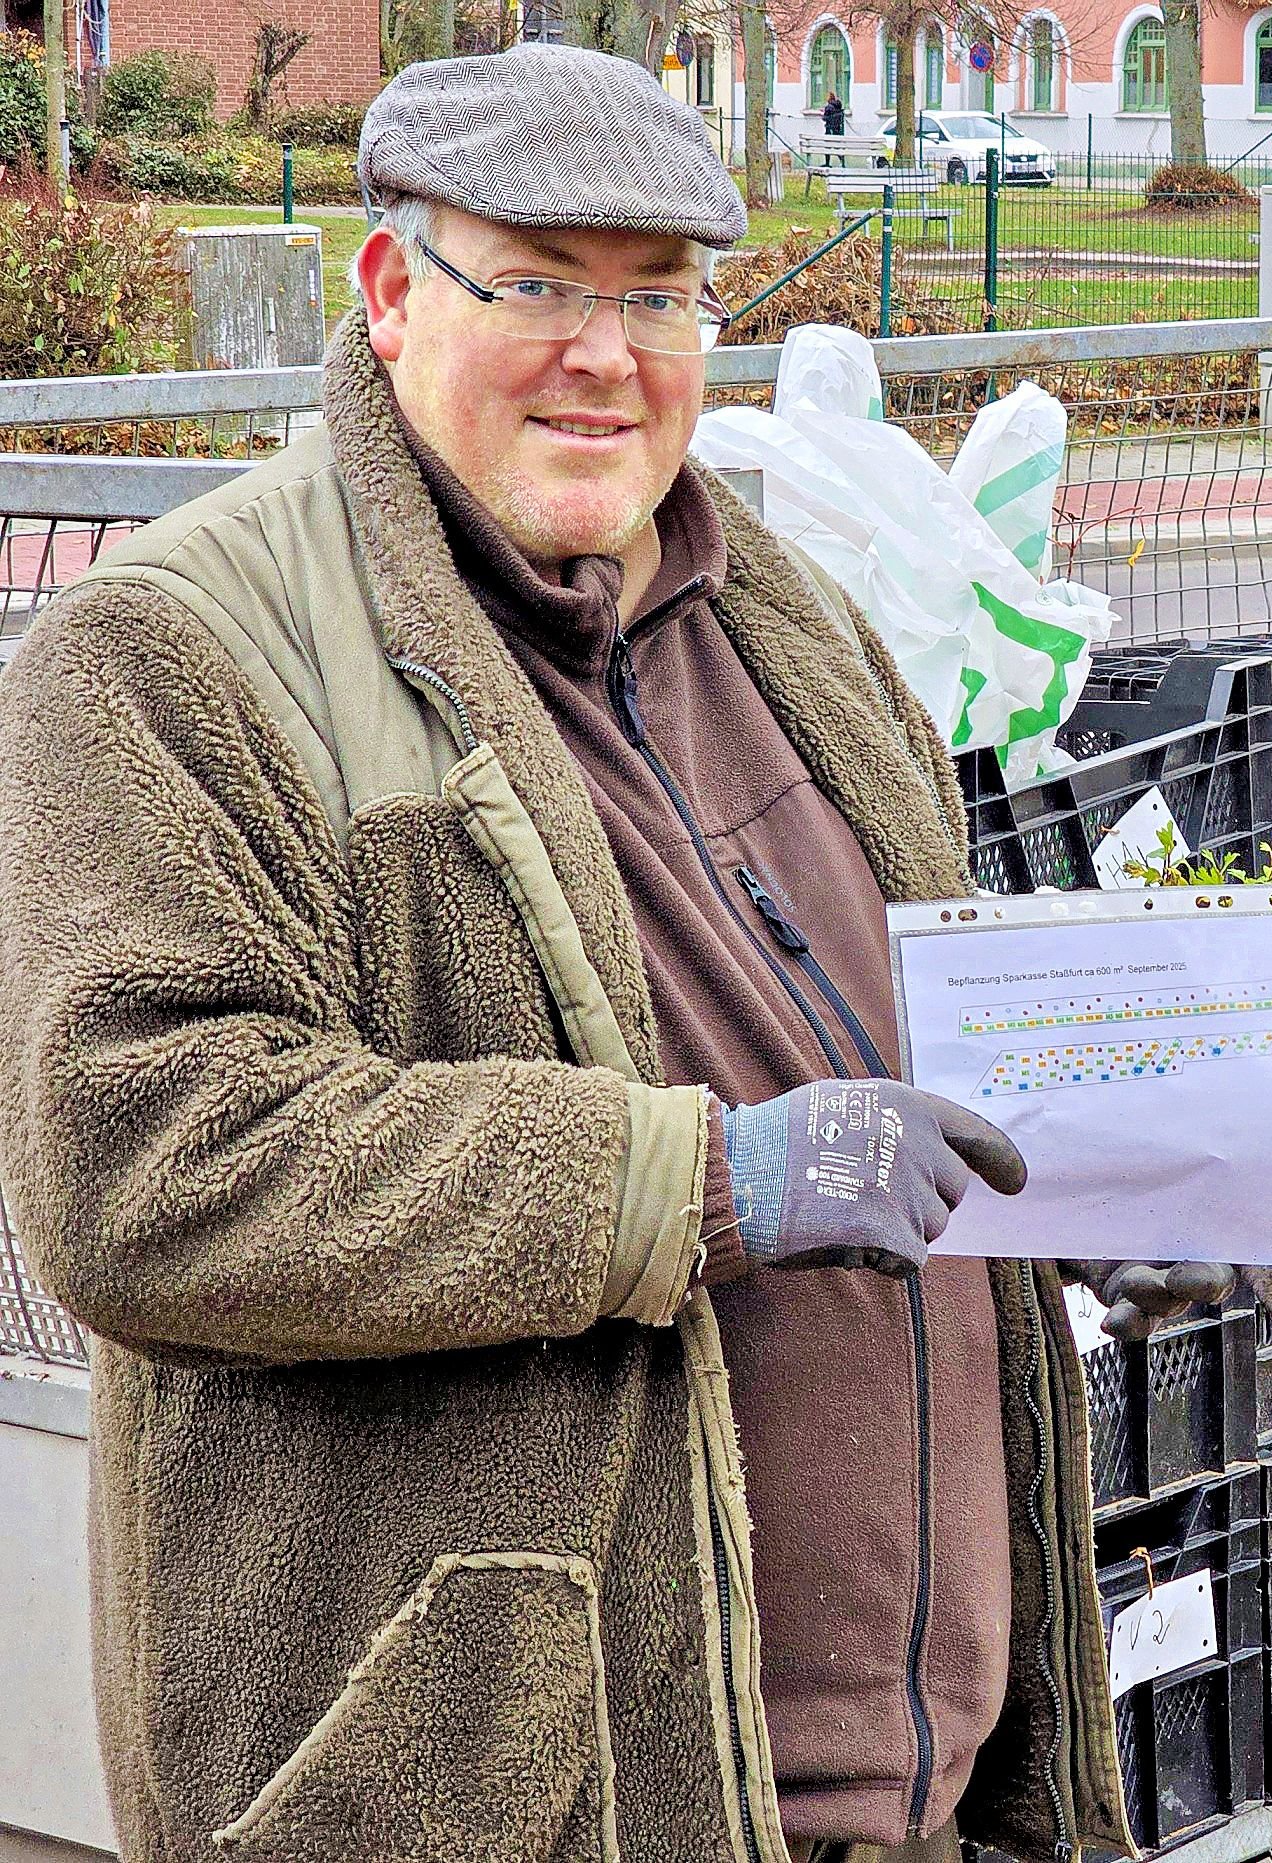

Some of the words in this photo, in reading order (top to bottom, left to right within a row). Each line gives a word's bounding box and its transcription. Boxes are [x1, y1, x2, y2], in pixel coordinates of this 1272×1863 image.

[948, 975, 1000, 987] Bepflanzung
[1002, 971, 1047, 984] Sparkasse
[1049, 967, 1083, 979] Staßfurt
[1096, 967, 1111, 976] 600
[1127, 963, 1169, 975] September
[1170, 962, 1187, 971] 2025
